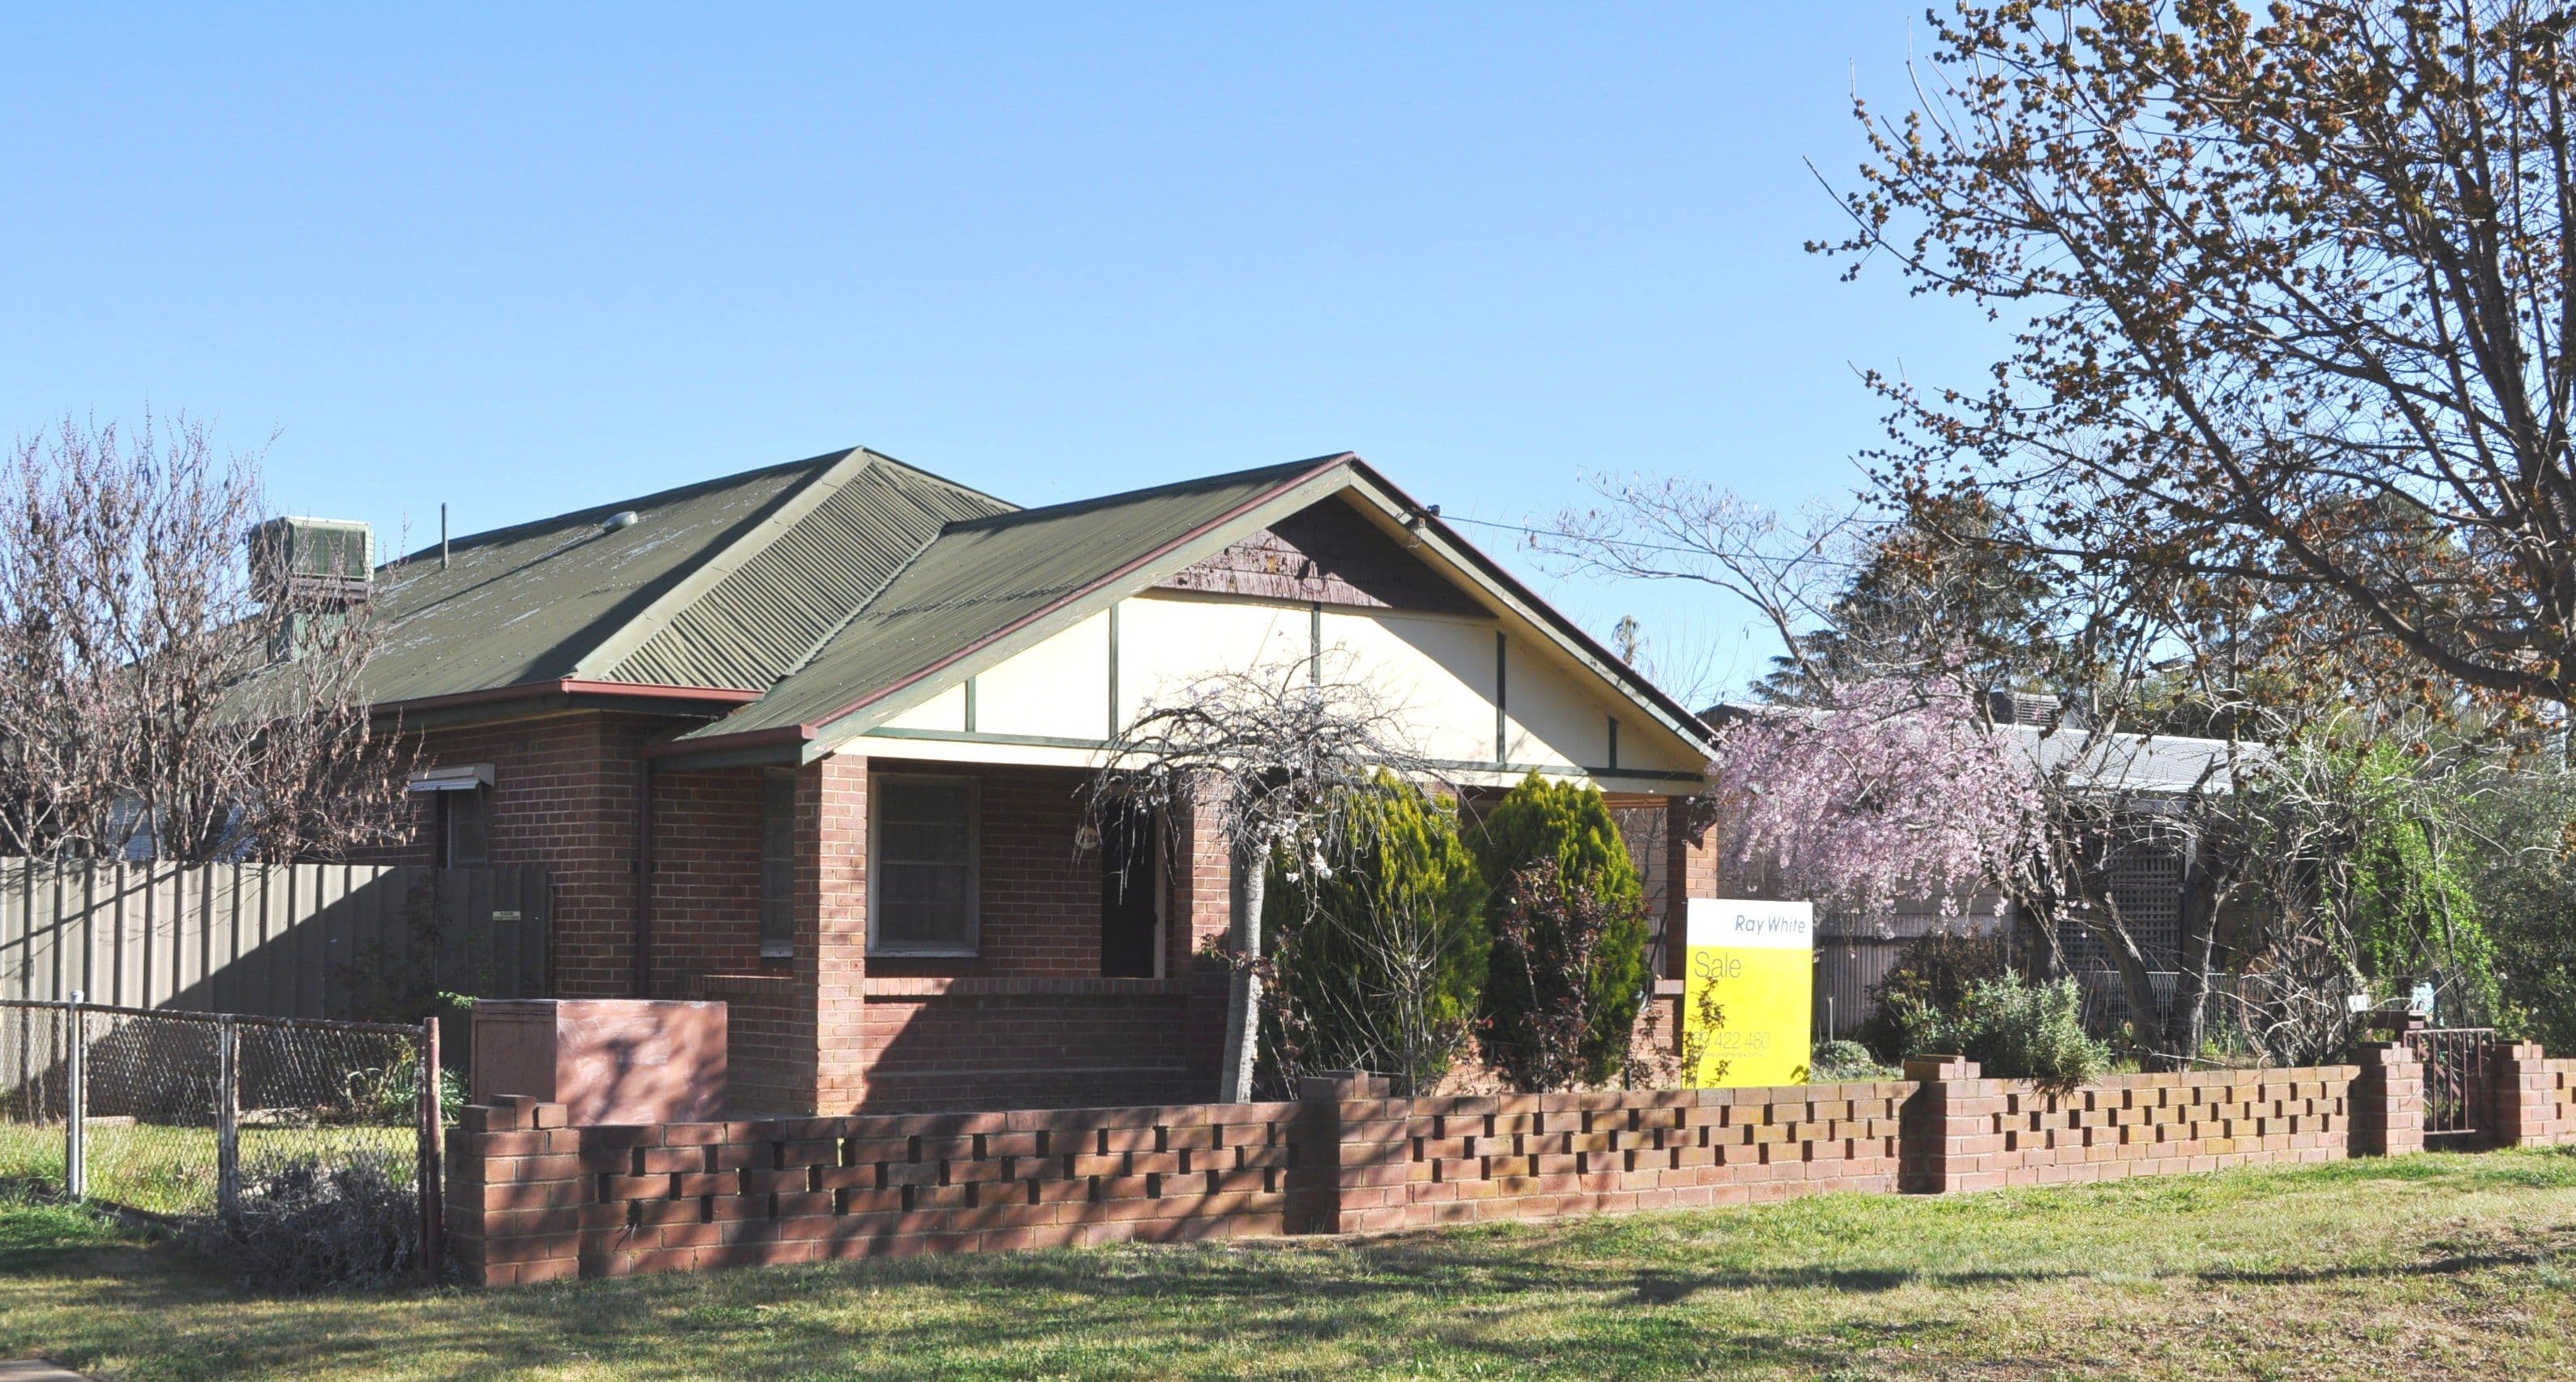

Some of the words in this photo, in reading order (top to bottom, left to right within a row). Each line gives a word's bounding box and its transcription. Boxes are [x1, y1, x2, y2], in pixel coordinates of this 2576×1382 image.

[1735, 914, 1764, 935] Ray
[1768, 915, 1806, 933] White
[1695, 951, 1741, 978] Sale
[1713, 1031, 1741, 1049] 422
[1744, 1031, 1771, 1049] 480
